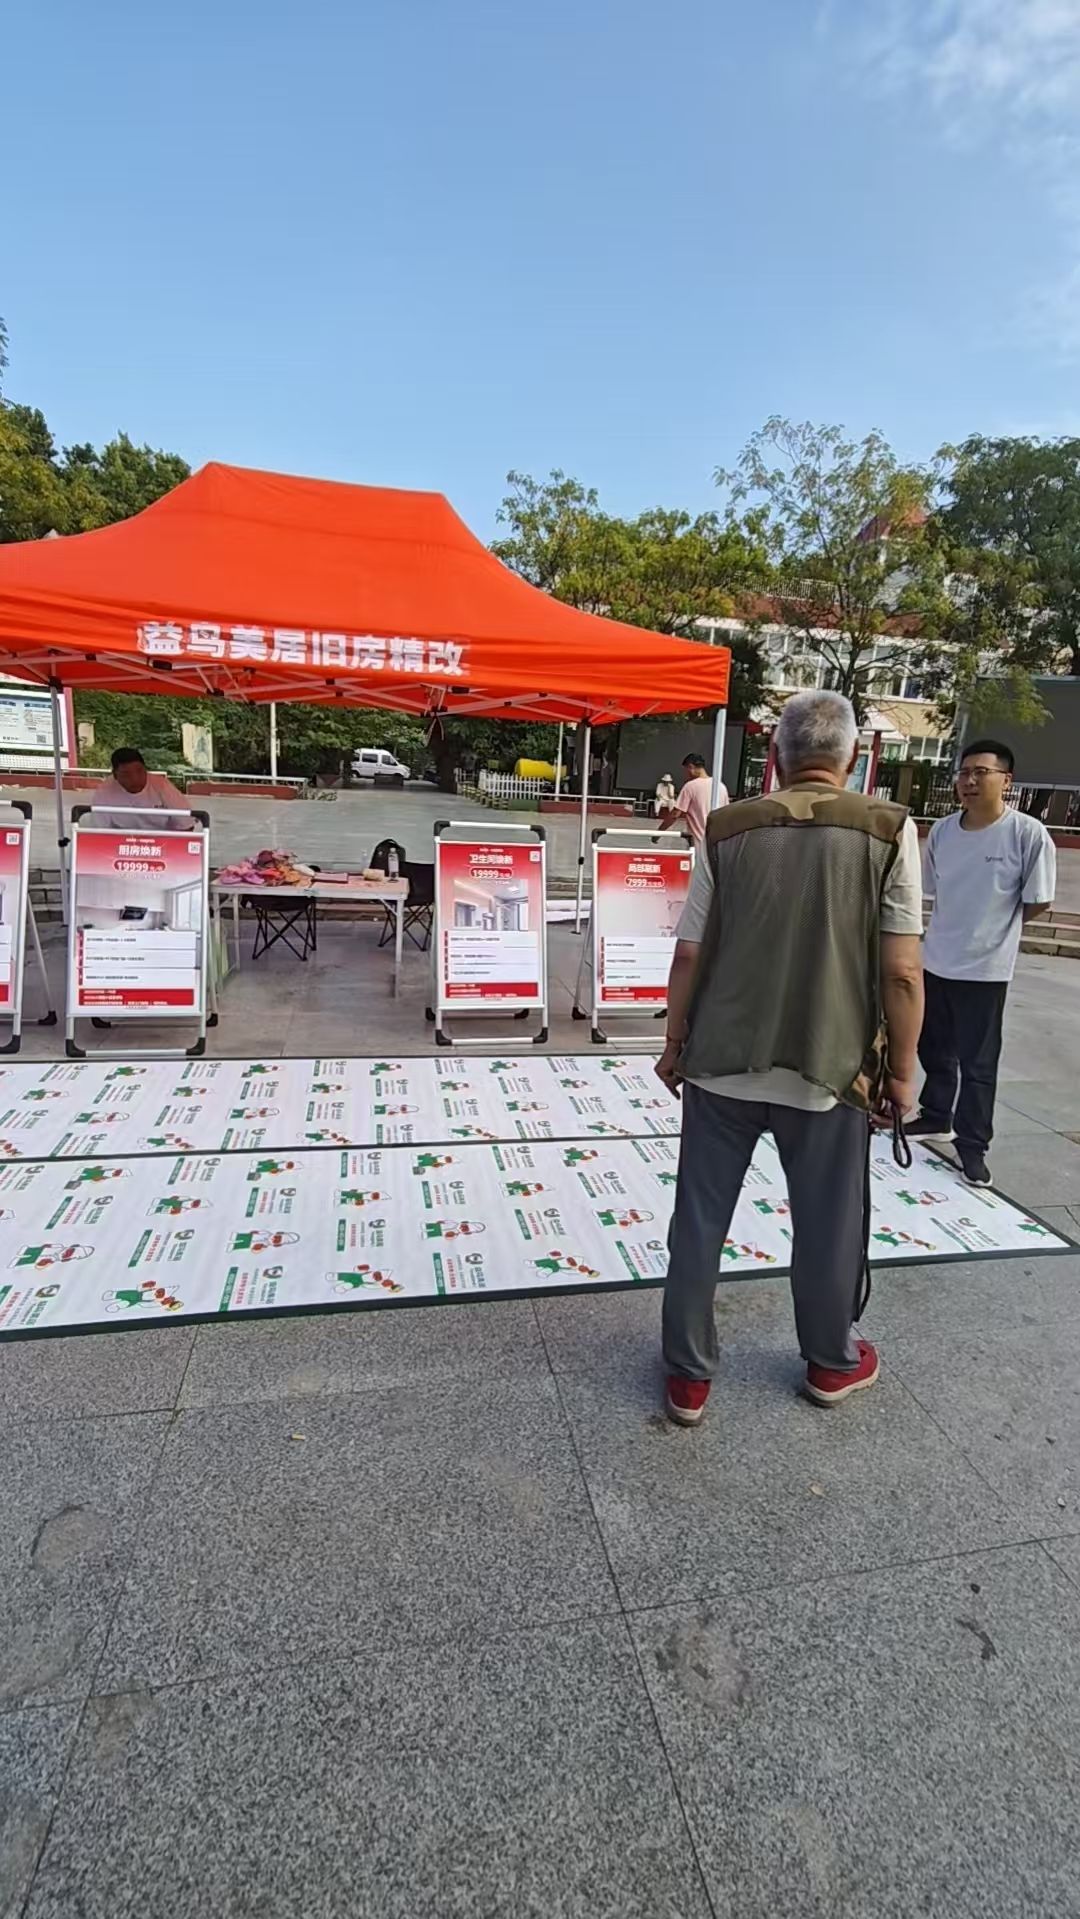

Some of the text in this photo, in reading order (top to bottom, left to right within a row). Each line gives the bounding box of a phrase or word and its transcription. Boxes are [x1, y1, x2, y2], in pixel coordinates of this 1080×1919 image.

[141, 621, 463, 675] 益鸟美居旧房精改
[116, 861, 149, 872] 19999
[472, 869, 499, 879] 19999
